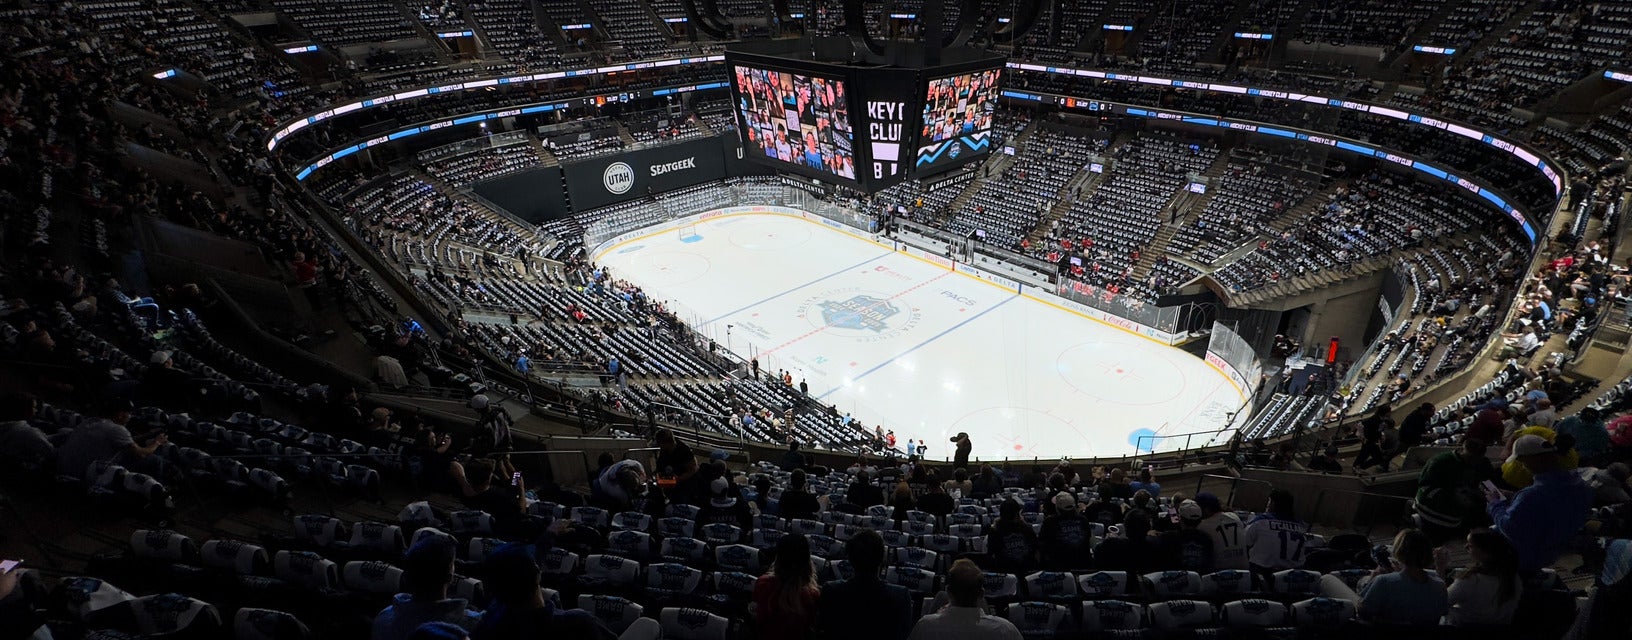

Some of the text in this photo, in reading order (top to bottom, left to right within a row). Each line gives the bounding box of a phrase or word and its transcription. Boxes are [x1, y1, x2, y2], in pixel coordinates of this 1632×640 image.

[867, 101, 896, 120] KEY
[736, 147, 743, 160] U
[650, 156, 696, 177] SEATGEEK
[873, 162, 882, 179] B
[608, 172, 630, 185] UTAH
[786, 178, 824, 194] DELTA CENTER
[935, 172, 974, 189] DELTA CENTER
[994, 276, 1016, 289] DELTA
[940, 290, 977, 307] PACS
[842, 300, 885, 320] SEASON
[1216, 522, 1237, 547] 17
[1278, 531, 1304, 561] 17
